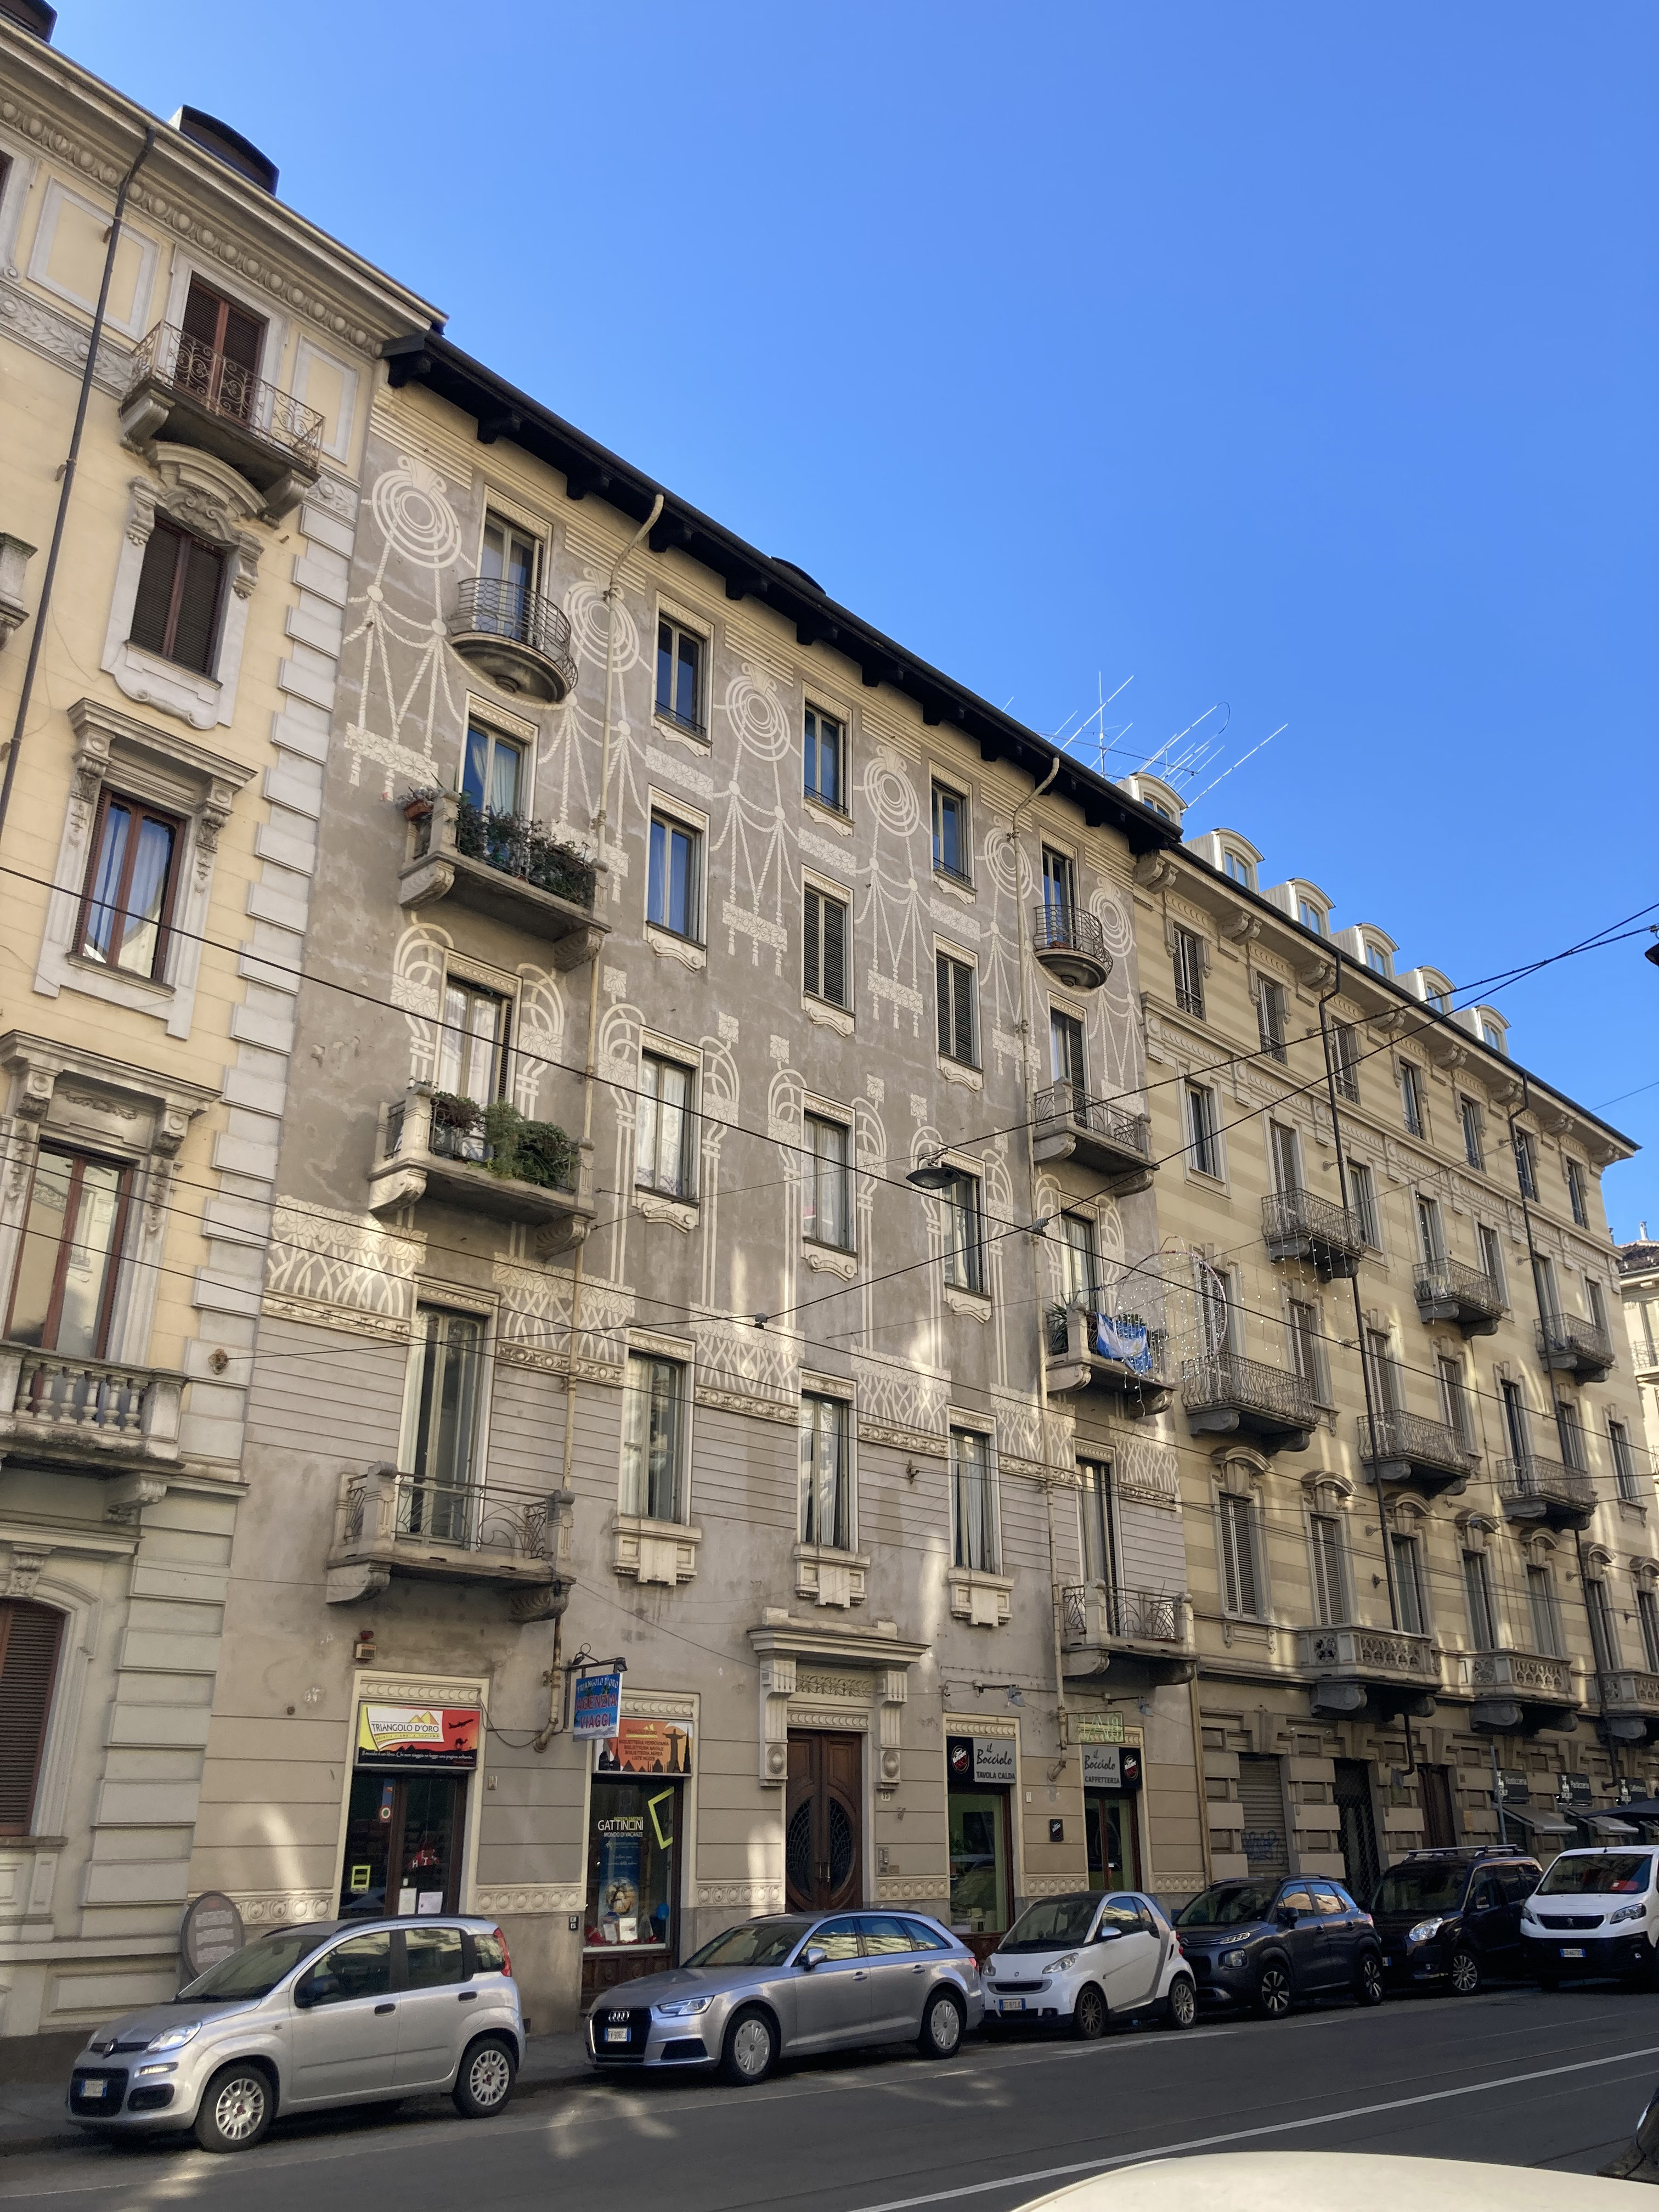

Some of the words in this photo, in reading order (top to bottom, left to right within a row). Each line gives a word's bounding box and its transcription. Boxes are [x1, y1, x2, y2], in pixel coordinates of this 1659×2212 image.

[577, 1678, 603, 1694] TRIANGOLO
[576, 1693, 617, 1711] AGENZIA
[371, 1723, 413, 1733] TRIANGOLO
[580, 1712, 612, 1729] VIAGGI
[976, 1749, 1012, 1765] Bocciolo
[1085, 1755, 1116, 1770] Bocciolo
[597, 1820, 644, 1831] GATTINONI
